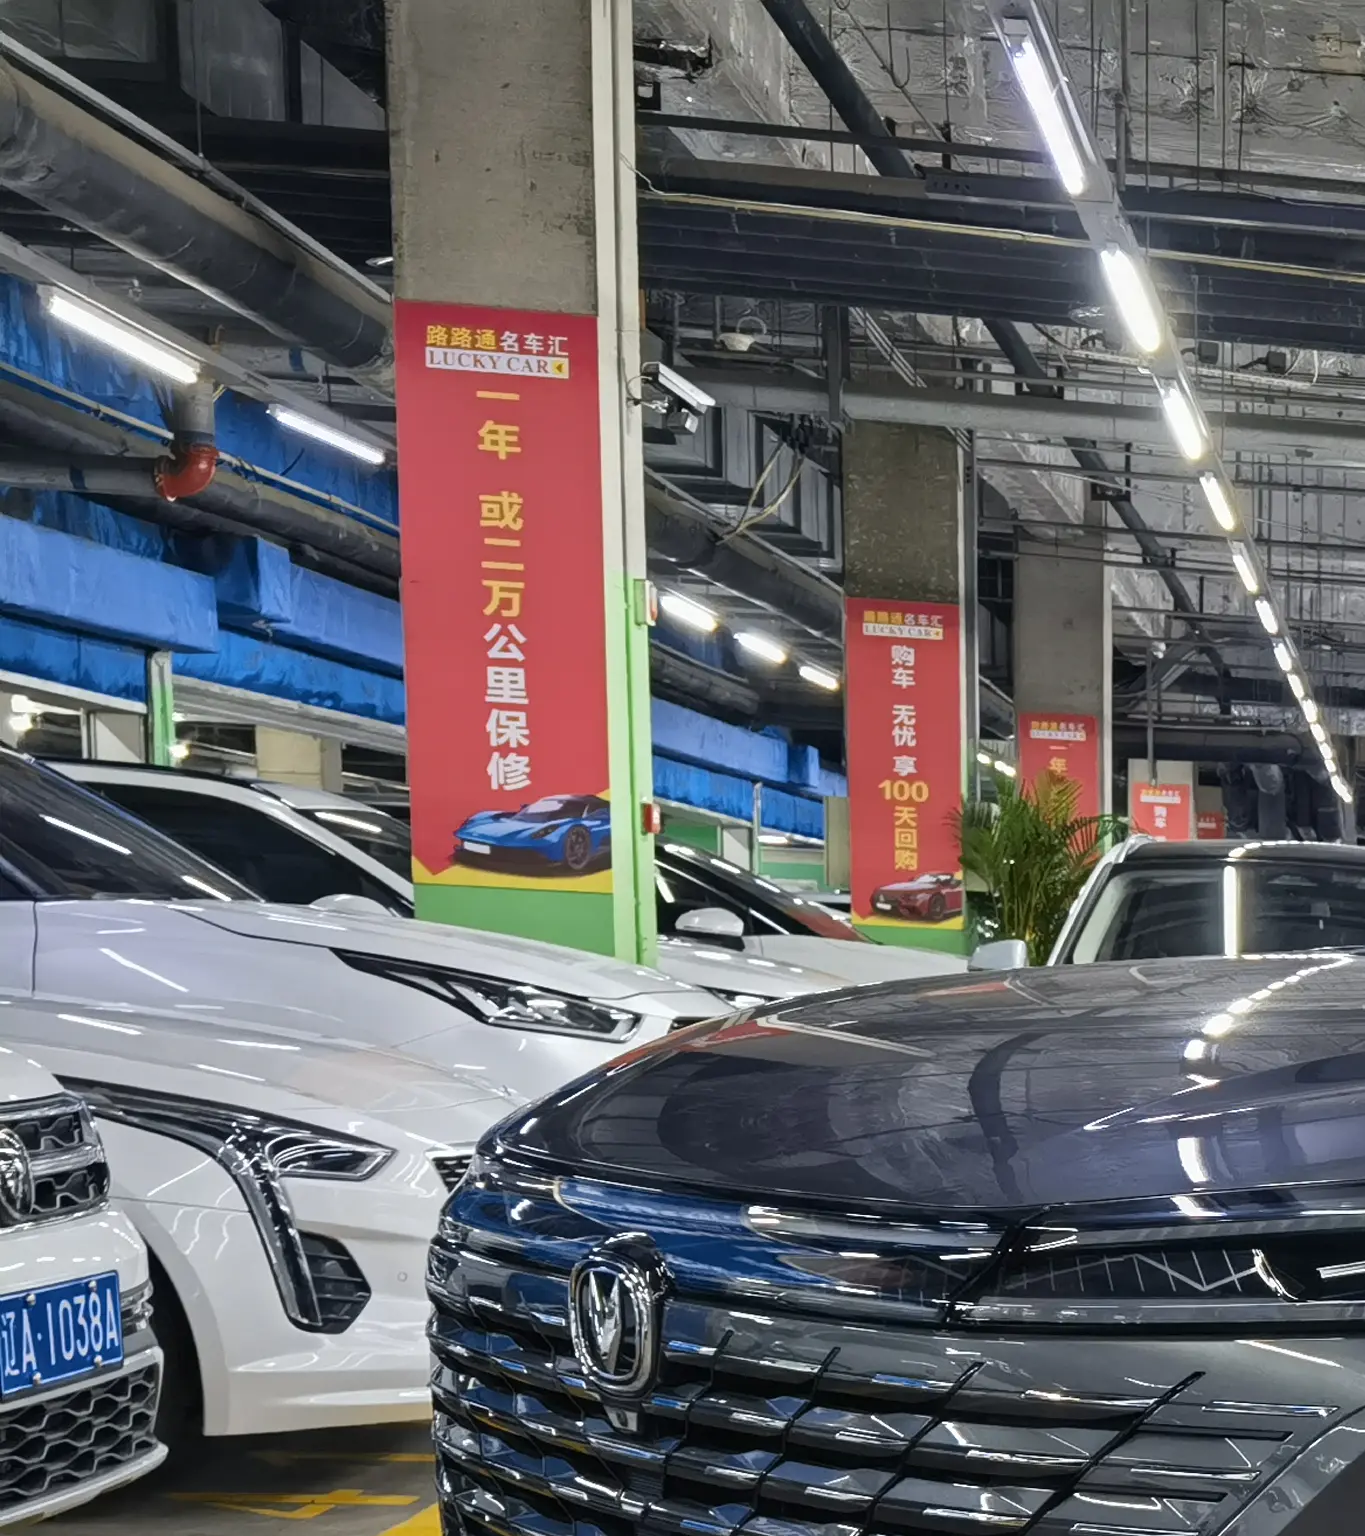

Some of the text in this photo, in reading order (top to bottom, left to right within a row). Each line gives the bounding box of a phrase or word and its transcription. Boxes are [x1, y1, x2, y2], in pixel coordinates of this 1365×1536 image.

[426, 325, 569, 356] 路路通名车汇
[429, 350, 550, 374] LUCKY CAR
